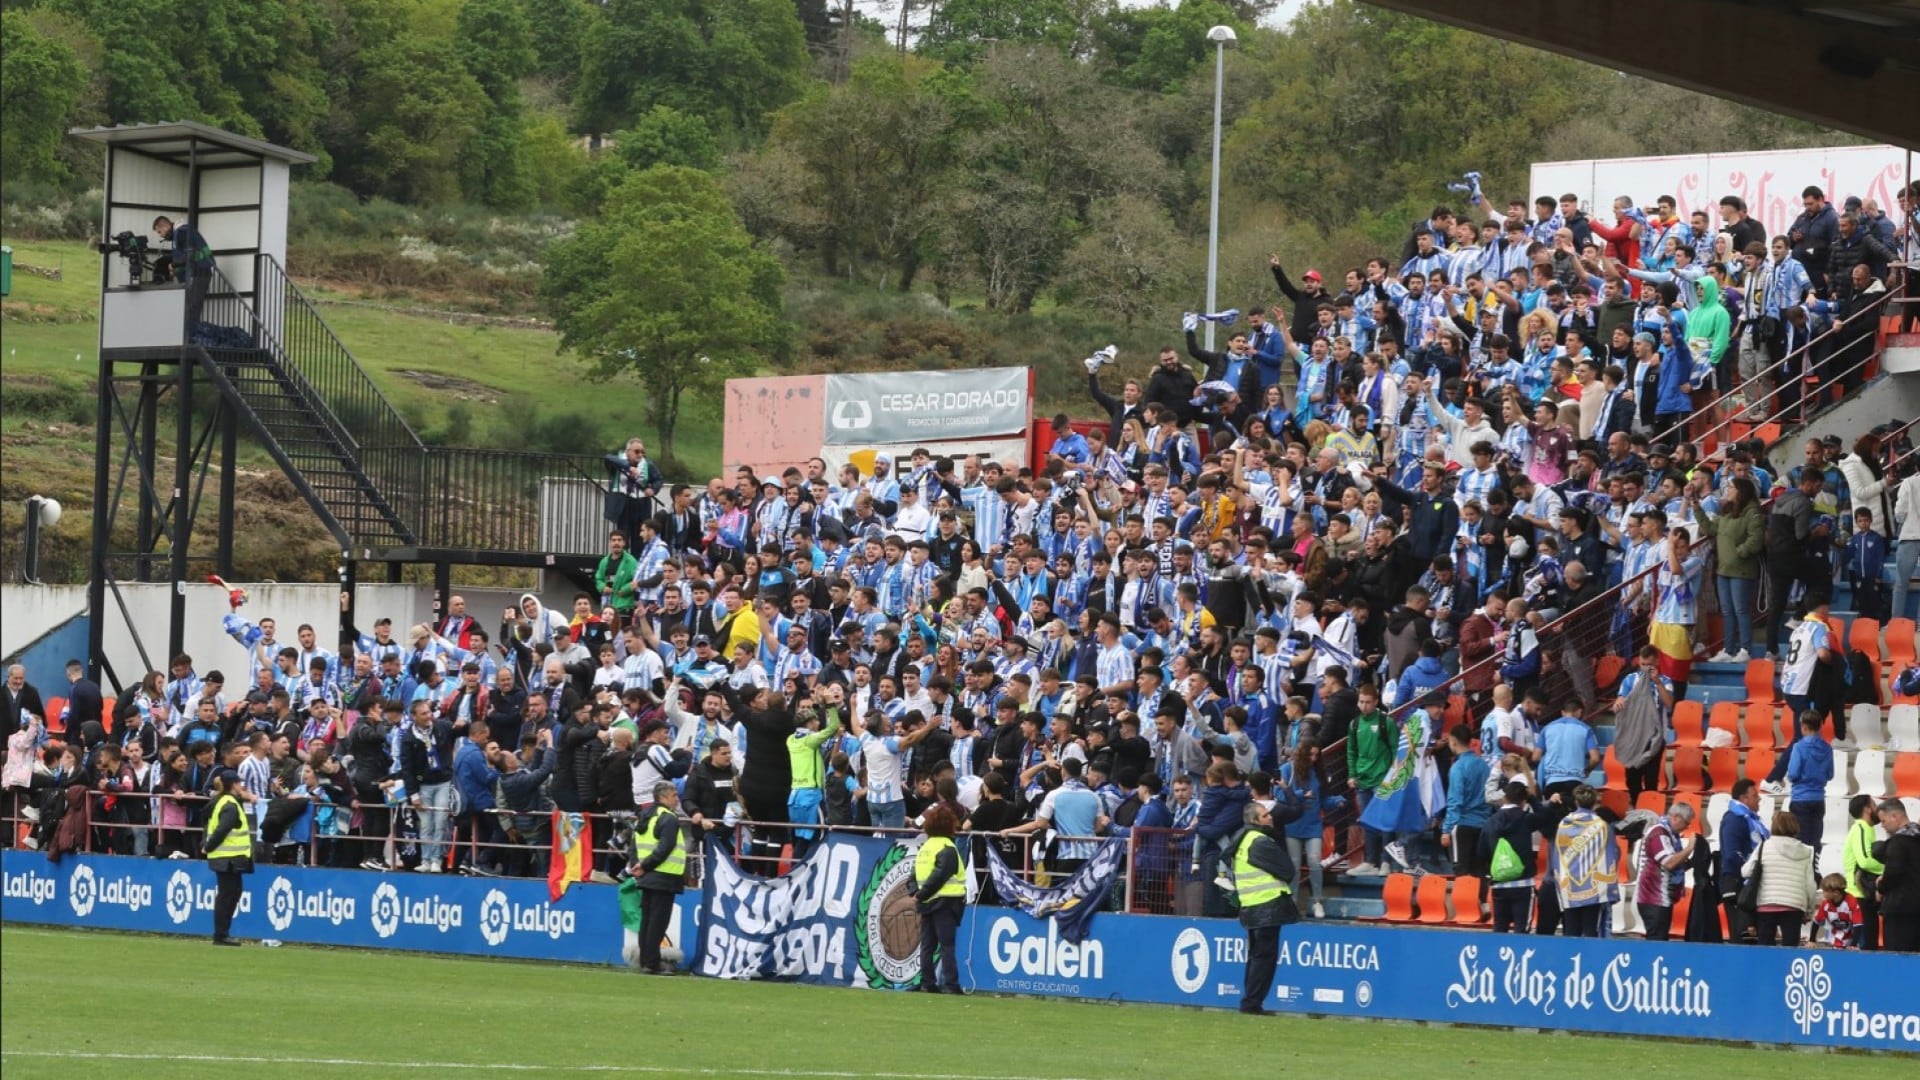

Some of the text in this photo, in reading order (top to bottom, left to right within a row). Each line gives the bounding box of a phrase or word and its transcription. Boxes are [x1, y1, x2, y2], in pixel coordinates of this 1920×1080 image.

[880, 389, 1020, 412] CESAR DORADO
[4, 870, 55, 905] LaLiga
[99, 875, 152, 912] LaLiga
[876, 861, 914, 901] MALAG
[297, 888, 355, 926] LaLiga
[404, 894, 462, 933] LaLiga
[514, 901, 576, 940] LaLiga
[773, 922, 846, 980] 1904
[989, 916, 1103, 979] Galen
[1297, 941, 1380, 971] GALLEGA
[997, 979, 1080, 994] CENTRO EDUCATIVO
[1446, 945, 1497, 1008] La
[1499, 946, 1557, 1016] Voz
[1564, 952, 1595, 1010] de
[1602, 952, 1711, 1017] Galicia
[1827, 1001, 1920, 1042] ribera
